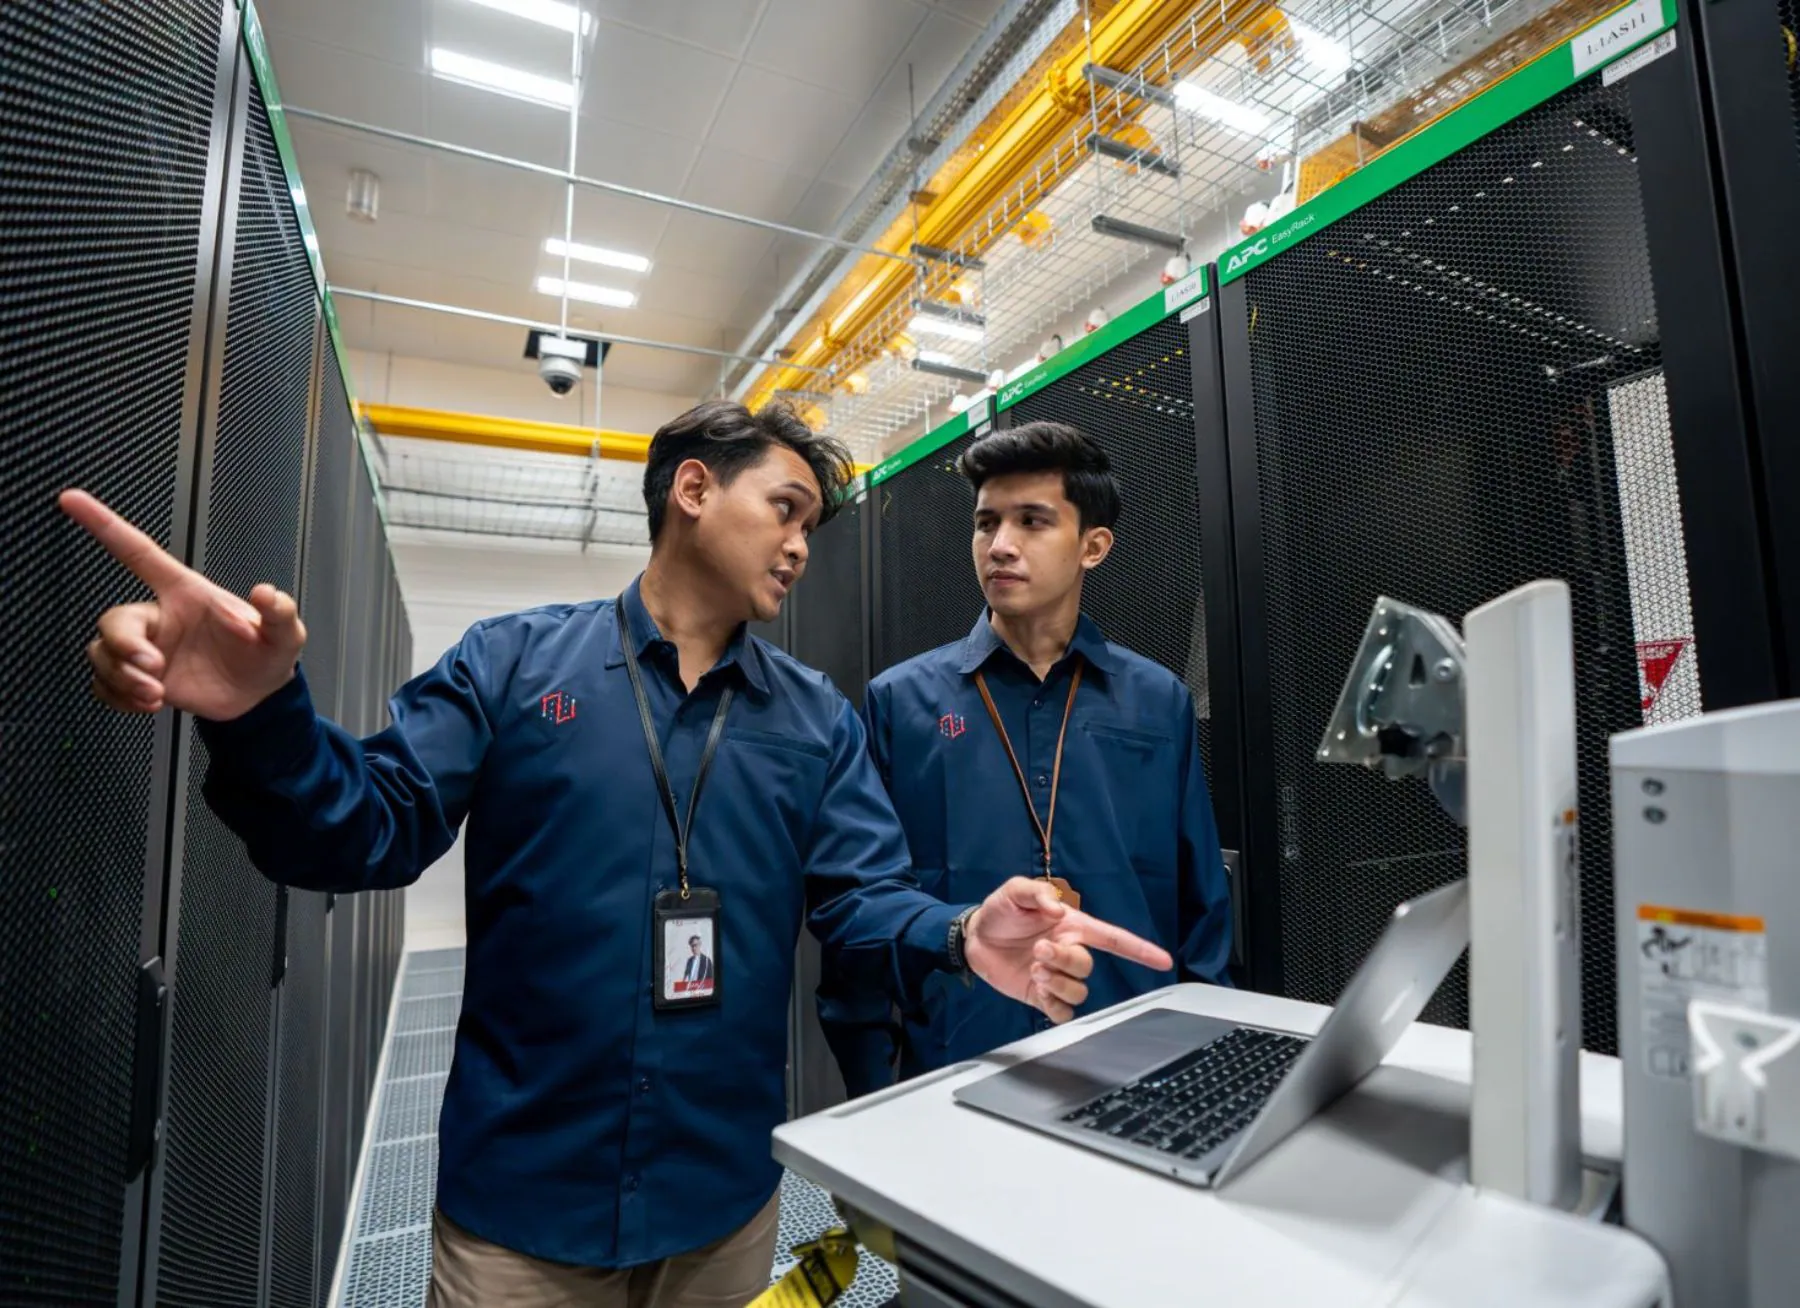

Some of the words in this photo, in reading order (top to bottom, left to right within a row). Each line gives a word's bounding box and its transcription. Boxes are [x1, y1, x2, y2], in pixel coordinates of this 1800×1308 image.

[1226, 237, 1268, 275] APC
[1272, 212, 1316, 245] EasyRack
[1000, 382, 1024, 406] APC
